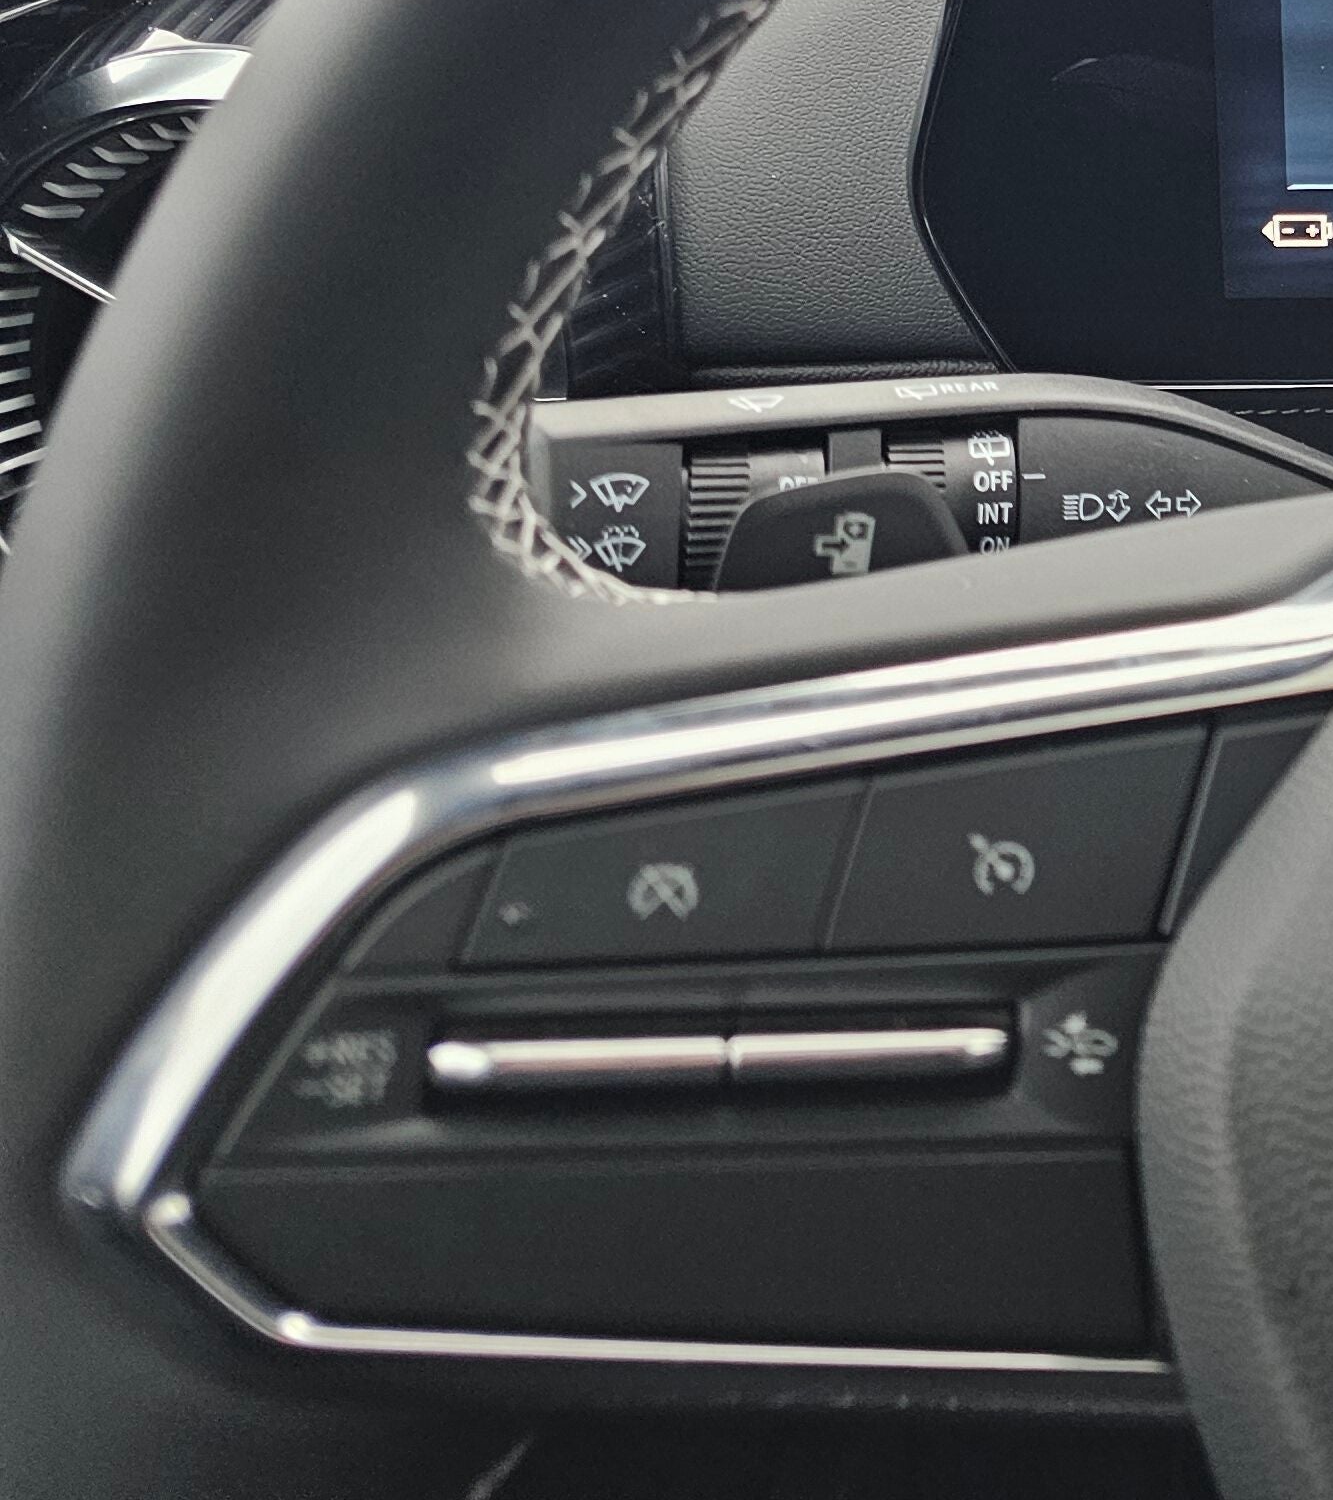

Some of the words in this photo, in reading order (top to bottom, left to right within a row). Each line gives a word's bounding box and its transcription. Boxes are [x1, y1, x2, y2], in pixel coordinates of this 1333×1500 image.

[940, 380, 999, 394] REAR
[973, 470, 1013, 493] OFF
[977, 501, 1014, 525] INT
